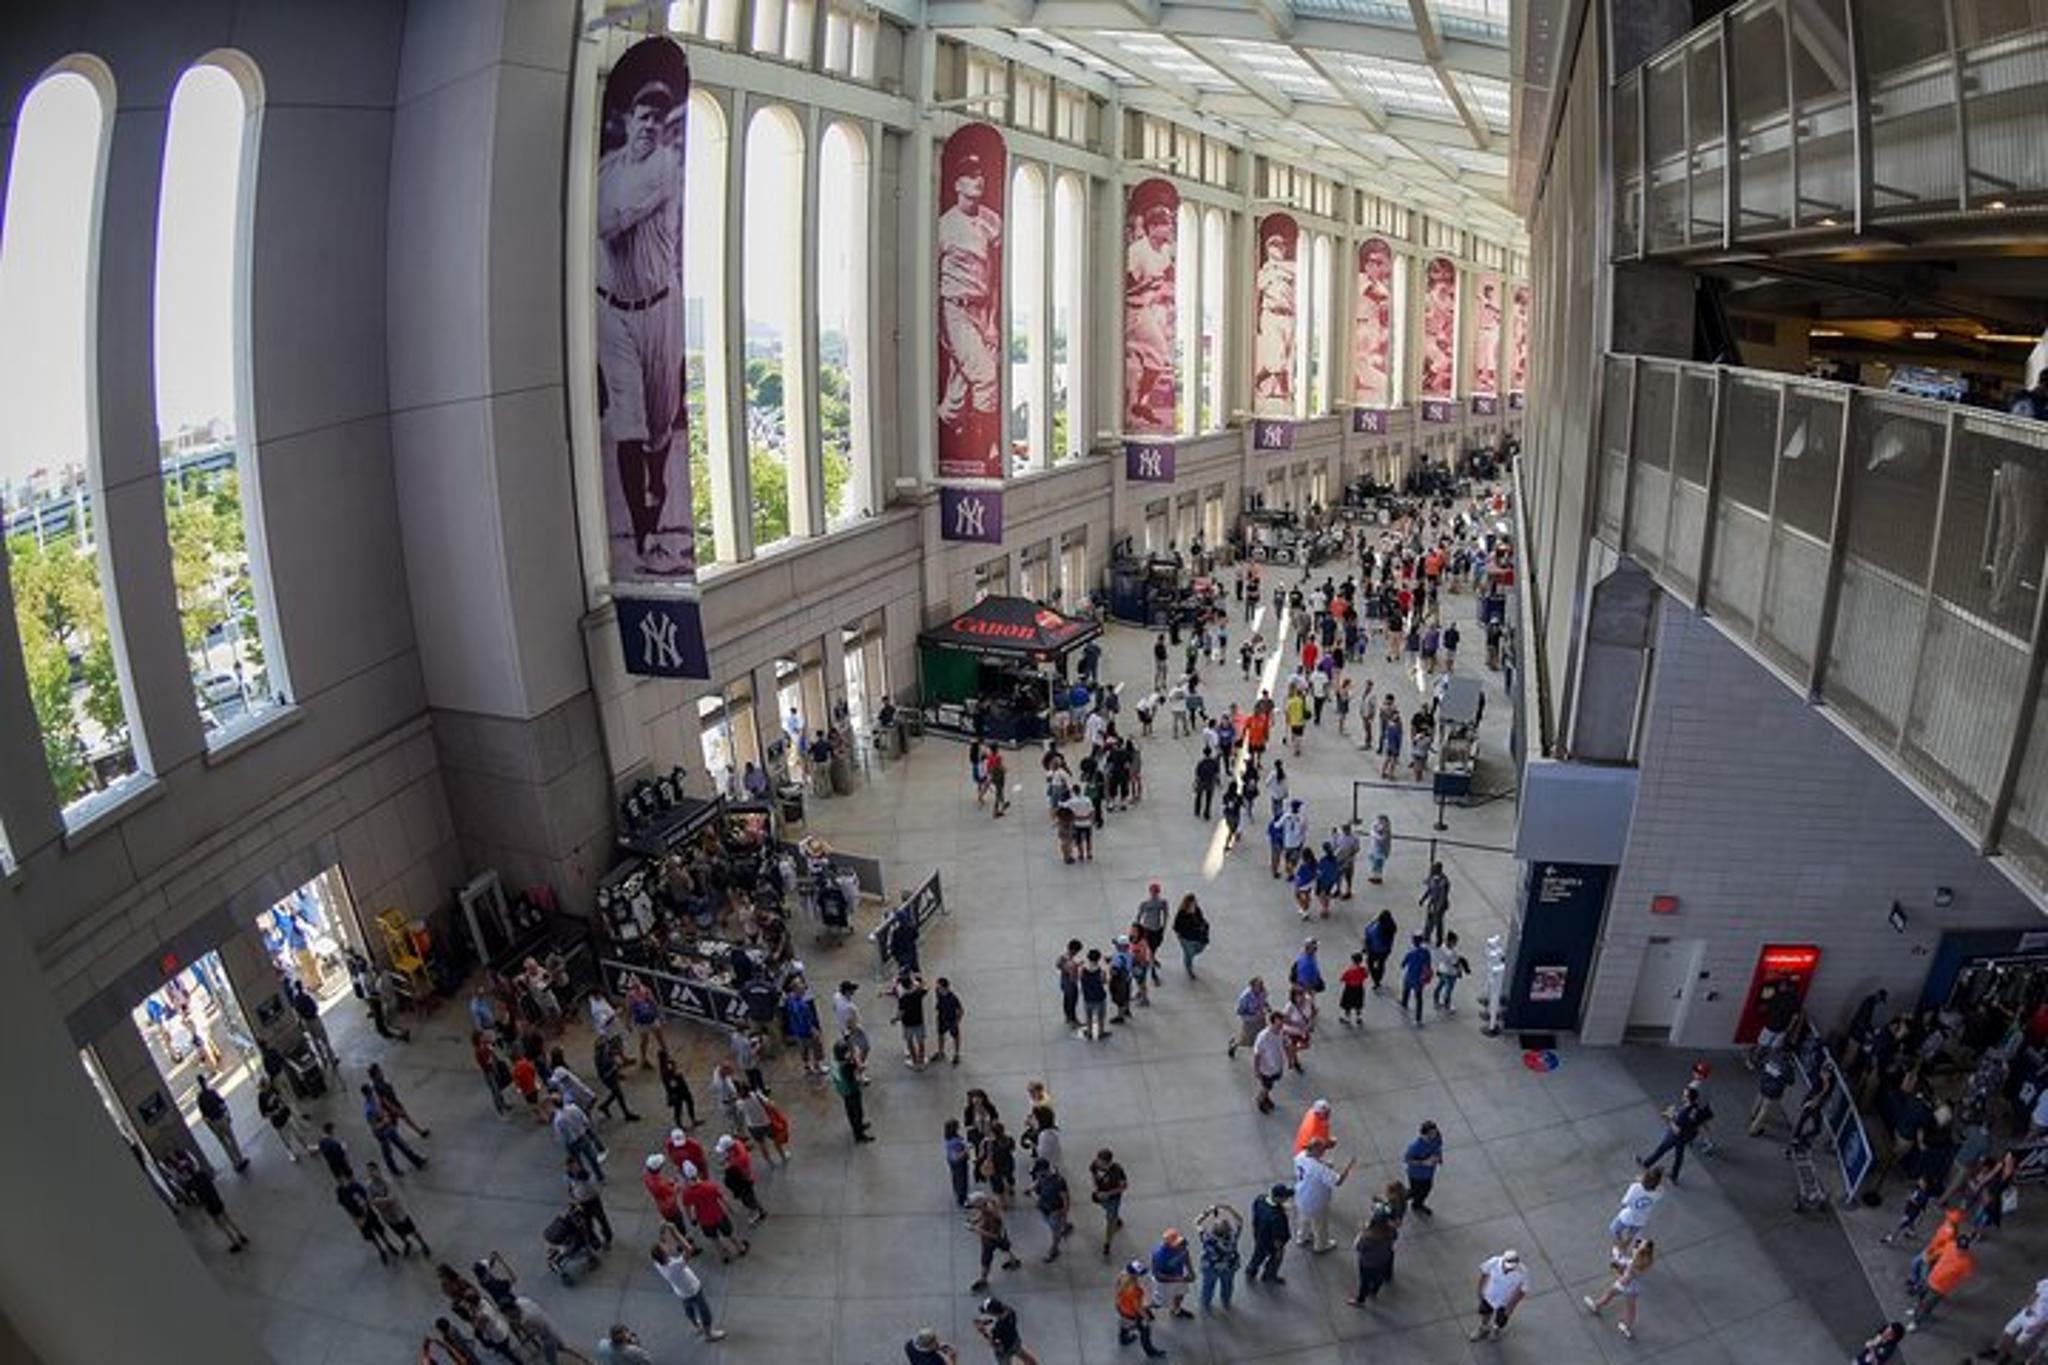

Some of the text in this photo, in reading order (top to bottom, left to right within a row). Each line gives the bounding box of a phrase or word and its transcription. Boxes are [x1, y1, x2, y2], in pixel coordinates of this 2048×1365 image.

[1138, 448, 1162, 476] NY
[955, 497, 985, 535] NY
[640, 610, 684, 668] NY
[952, 616, 1036, 640] Canon
